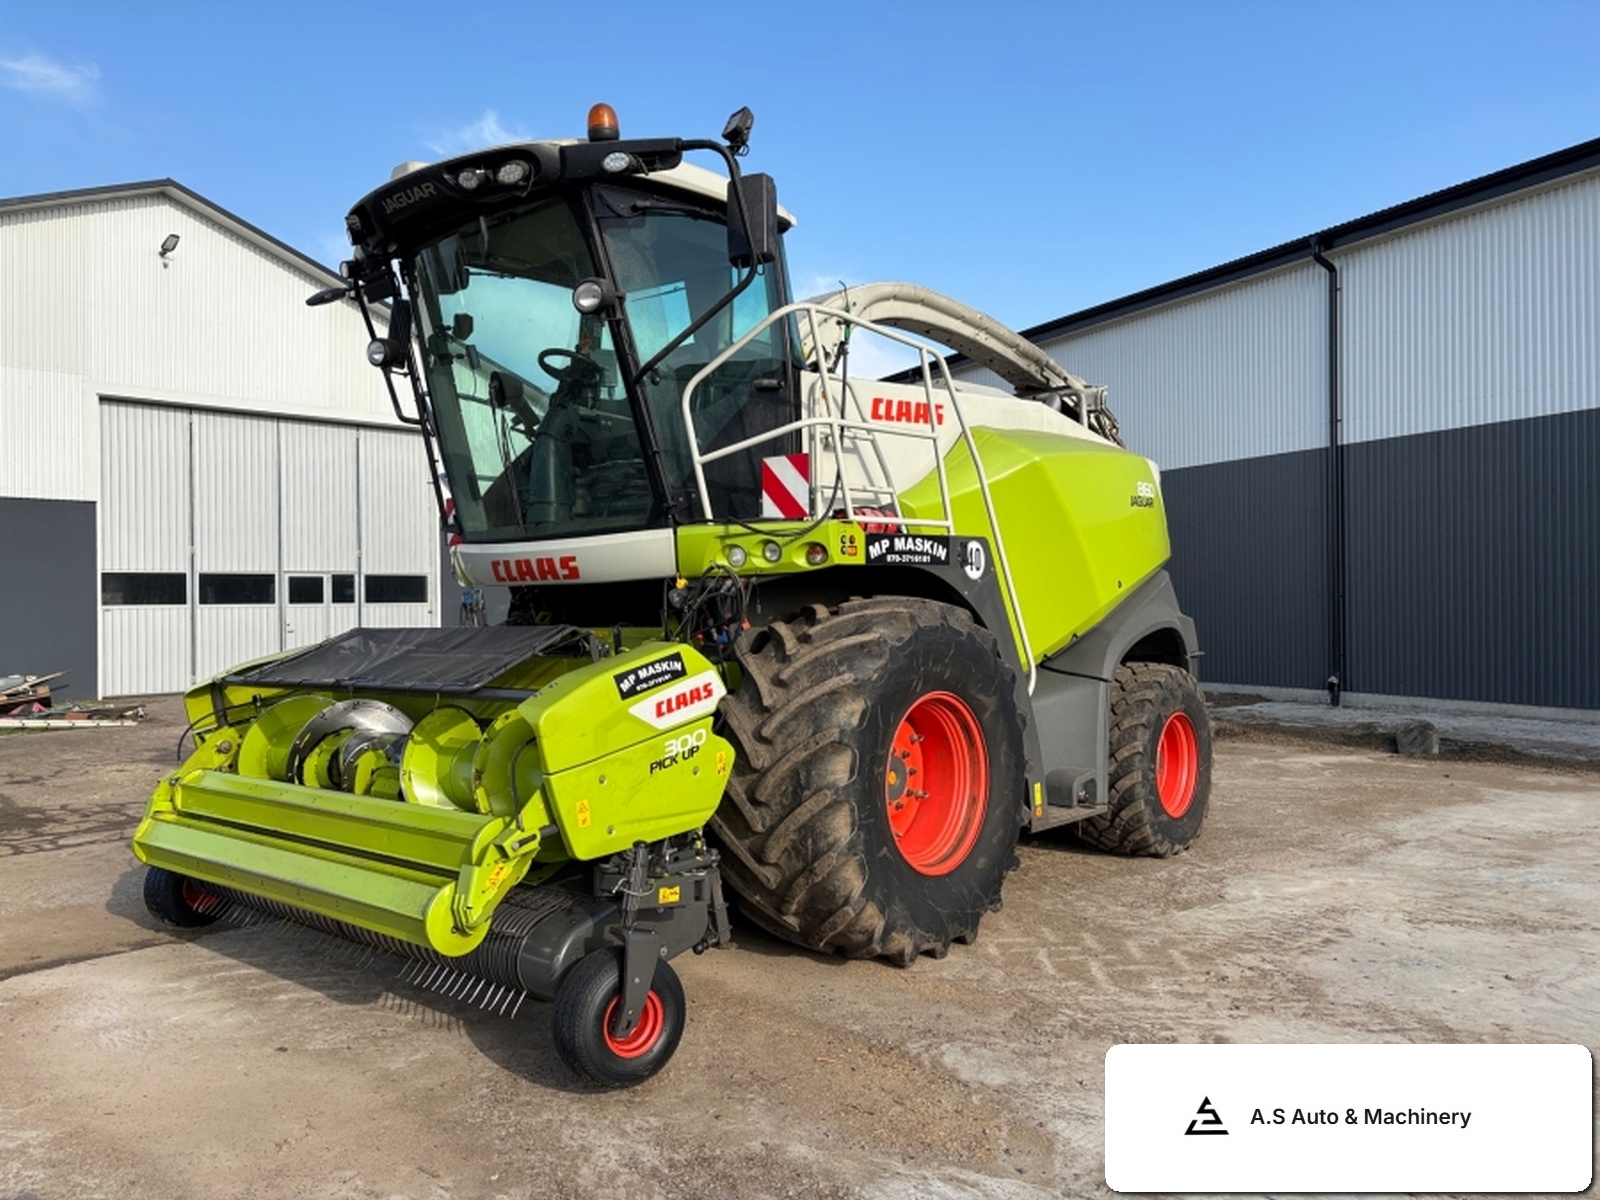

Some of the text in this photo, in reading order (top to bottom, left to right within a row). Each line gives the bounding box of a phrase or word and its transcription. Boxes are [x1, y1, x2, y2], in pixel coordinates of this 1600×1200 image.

[381, 182, 437, 215] JAGUAR
[871, 397, 944, 425] CLAAS
[1130, 495, 1154, 508] JAGUAR
[868, 537, 947, 560] MP MASKIN
[491, 555, 580, 582] CLAAS
[619, 673, 636, 692] MP
[637, 660, 682, 679] MASKIN
[655, 682, 713, 718] CLAAS
[664, 728, 707, 758] 300
[649, 744, 700, 774] PICK UP
